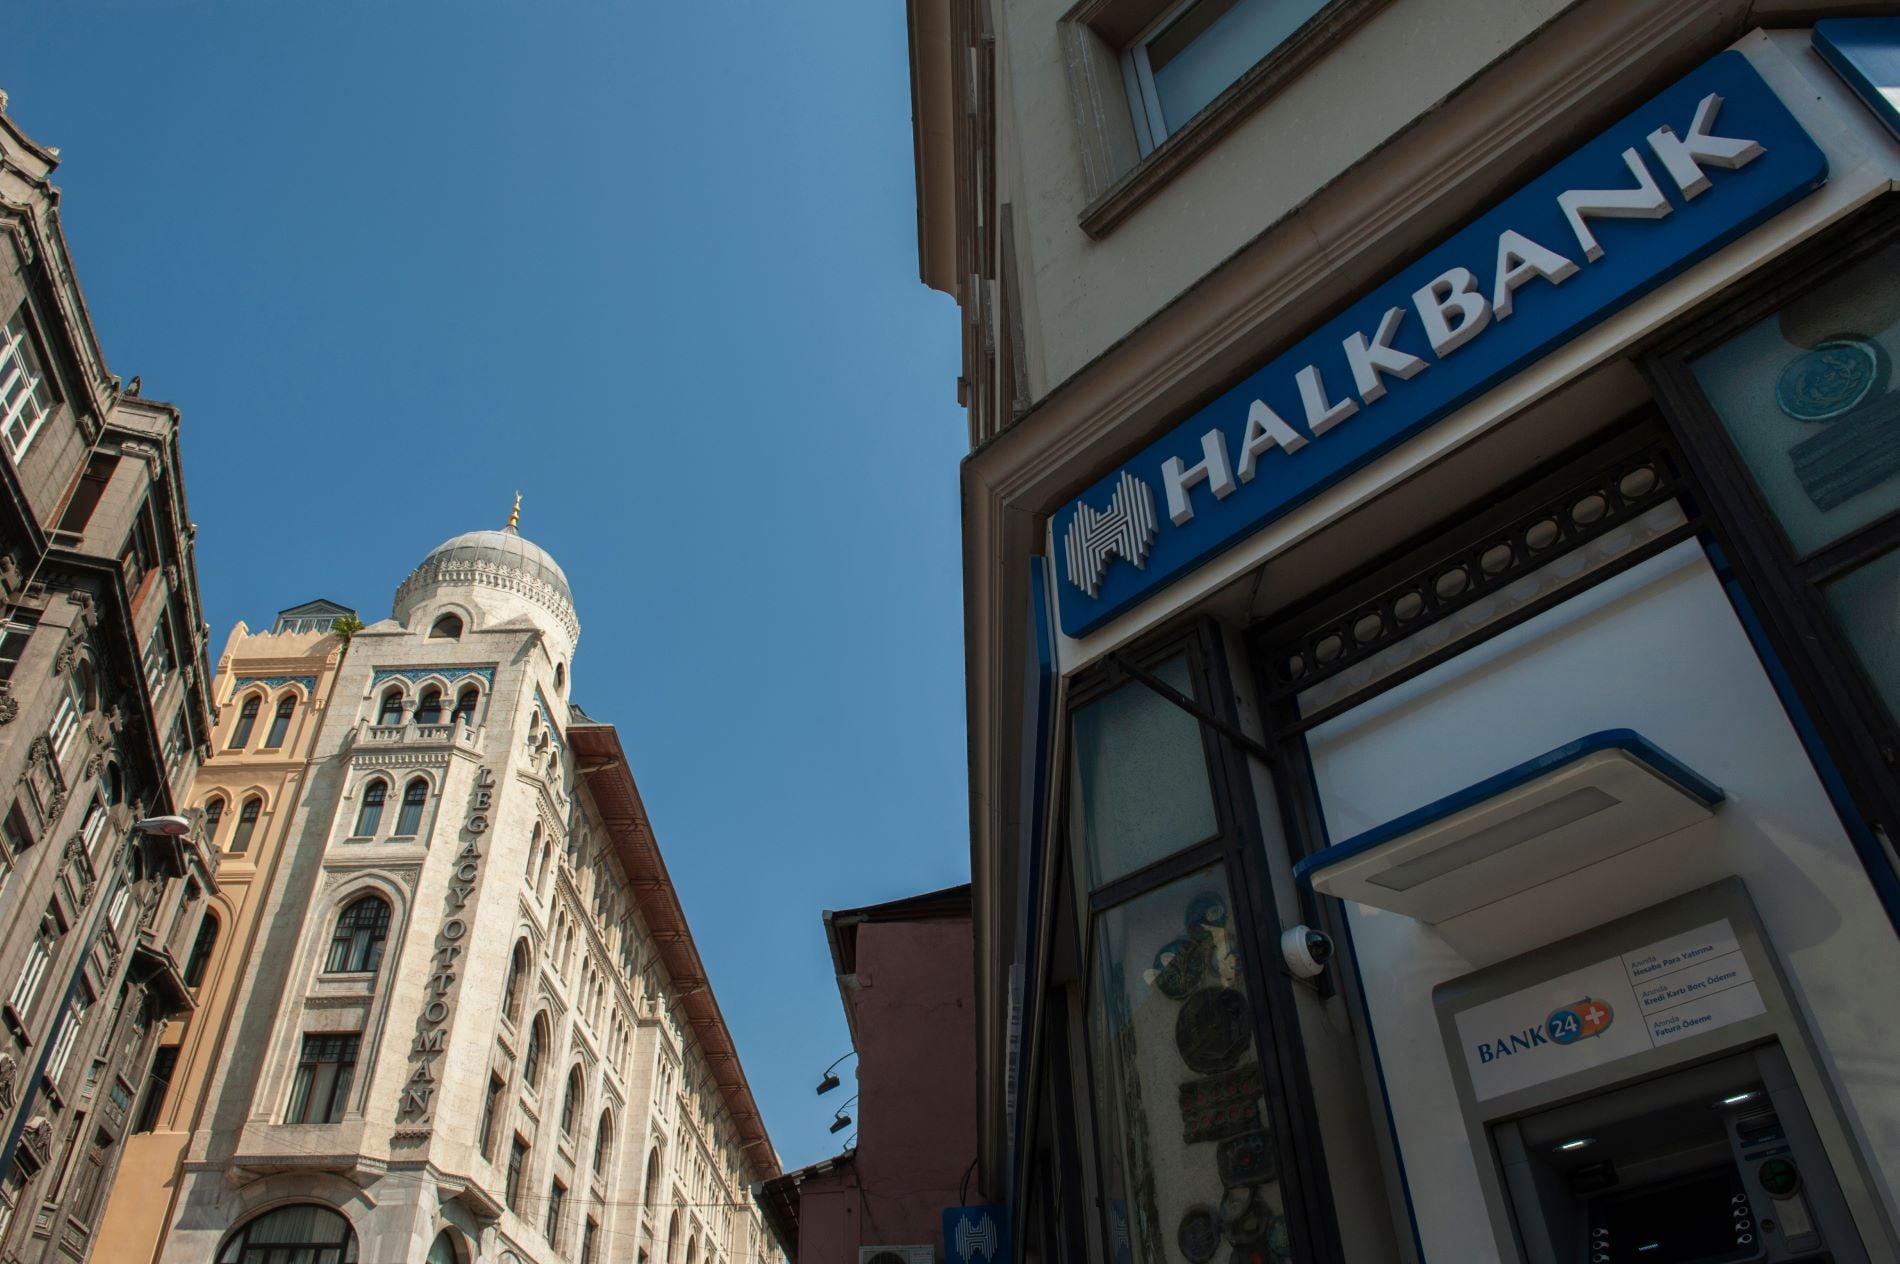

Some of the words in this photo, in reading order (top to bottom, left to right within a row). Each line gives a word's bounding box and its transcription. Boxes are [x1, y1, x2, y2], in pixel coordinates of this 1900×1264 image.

[1161, 92, 1767, 528] HALKBANK
[452, 767, 495, 907] LEGACY
[1633, 963, 1661, 976] Hesaba
[1663, 955, 1681, 967] Para
[1682, 945, 1713, 959] Yatırma
[1644, 992, 1665, 1006] Kredi
[1667, 985, 1686, 998] Kartı
[1688, 980, 1707, 992] Borç
[1707, 971, 1736, 985] Ödeme
[403, 919, 467, 1113] OTTOMAN
[1655, 1022, 1681, 1037] Fatura
[1682, 1014, 1712, 1028] Ödeme
[1478, 1025, 1548, 1064] BANK
